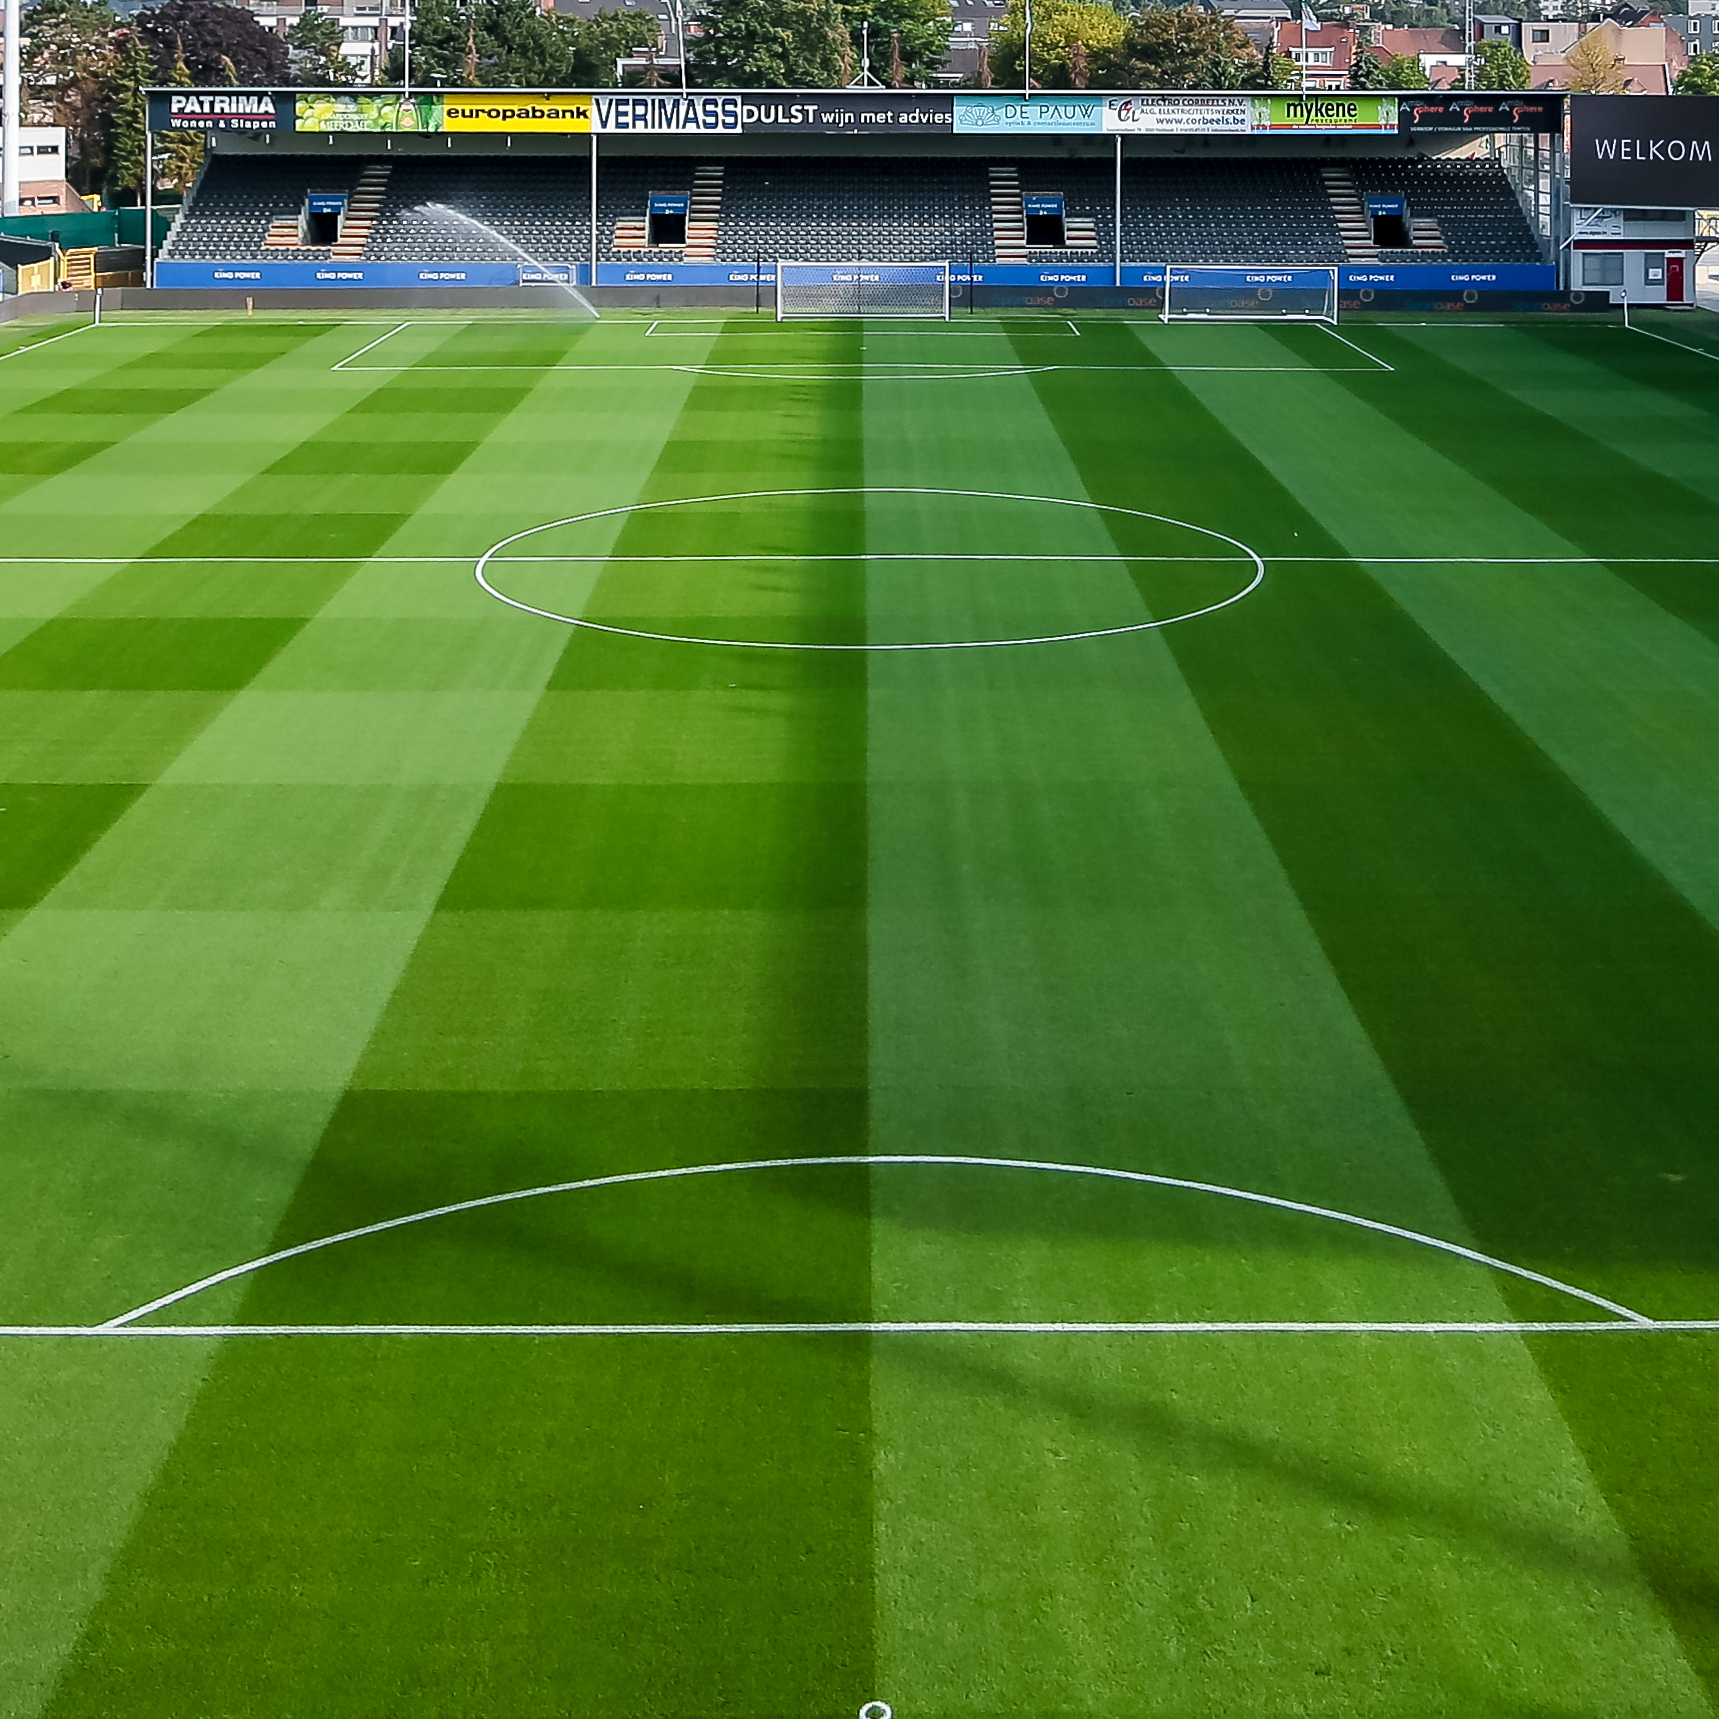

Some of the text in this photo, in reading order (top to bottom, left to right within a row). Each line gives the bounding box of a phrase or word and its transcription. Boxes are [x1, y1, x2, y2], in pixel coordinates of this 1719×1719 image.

[171, 95, 275, 113] PATRIMA
[1141, 98, 1246, 106] ELECTRO CORBEELS N.V.
[446, 107, 589, 121] europabank
[594, 98, 738, 129] VERIMASS
[742, 105, 952, 127] DULST wijn met advies
[1005, 104, 1095, 118] DE PAUW
[1286, 97, 1358, 124] mykene
[171, 119, 276, 129] Wonen & Slapen
[1156, 116, 1246, 125] www.corbeels.be
[1595, 139, 1712, 161] WELKOM
[419, 272, 438, 280] KING
[1369, 274, 1395, 282] POWER
